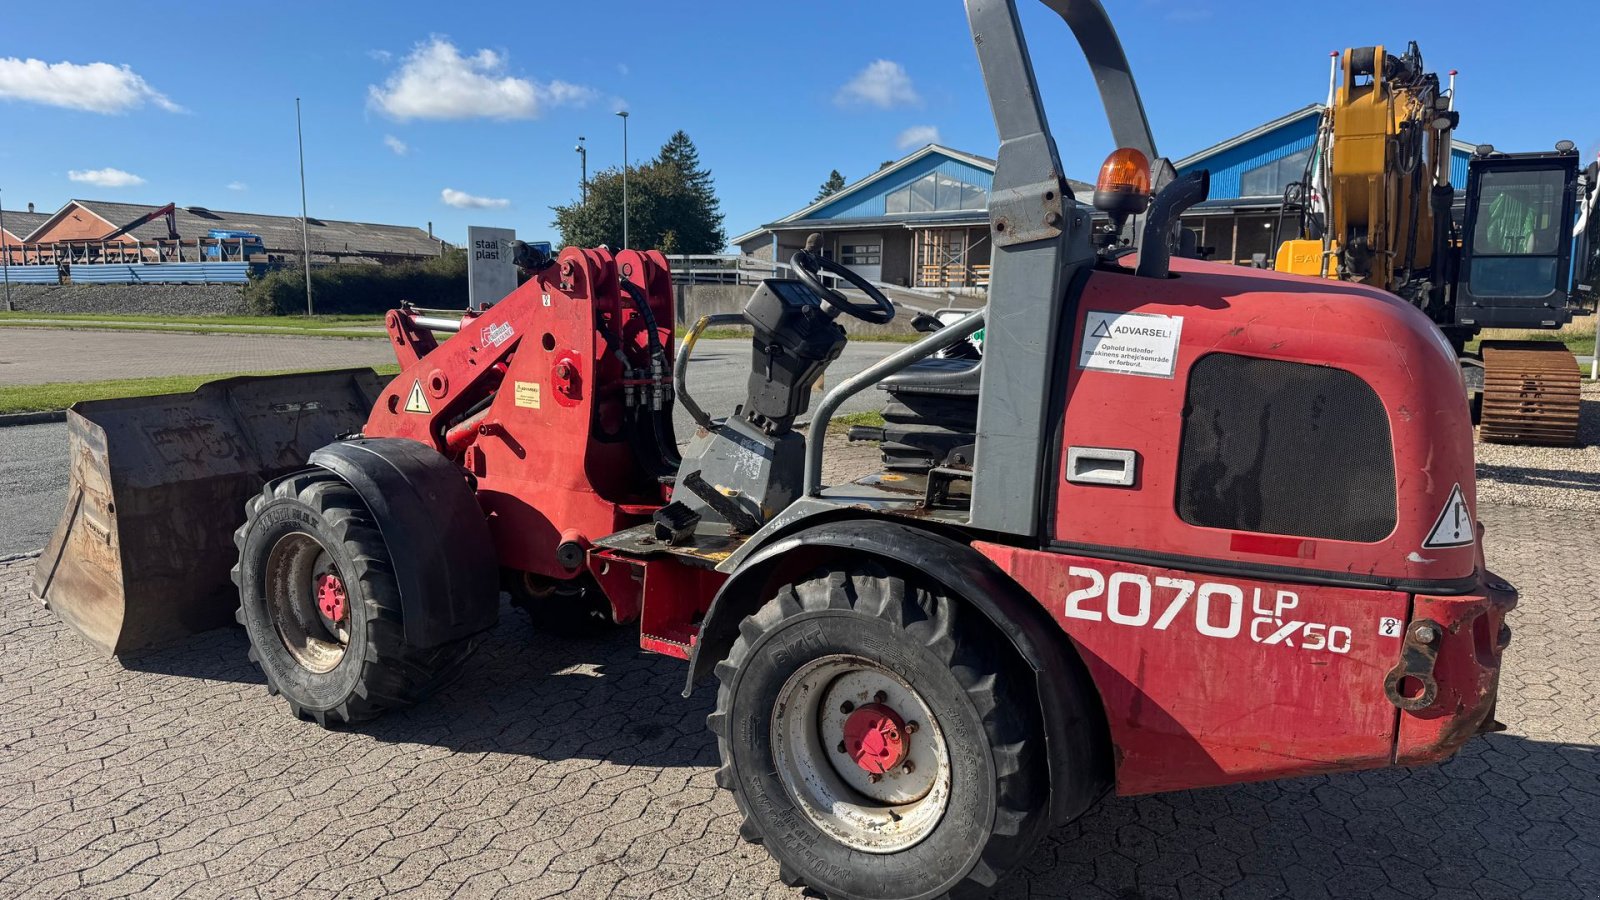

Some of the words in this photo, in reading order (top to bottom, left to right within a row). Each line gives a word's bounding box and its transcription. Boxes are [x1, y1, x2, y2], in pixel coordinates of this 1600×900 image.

[475, 239, 499, 250] staal
[476, 249, 500, 261] plast
[1114, 325, 1172, 339] ADVARSEL!
[1101, 343, 1125, 352] Ophold
[1126, 345, 1154, 354] indenfor
[1065, 566, 1244, 639] 2070
[1253, 587, 1299, 617] LP
[1250, 616, 1352, 654] CX50
